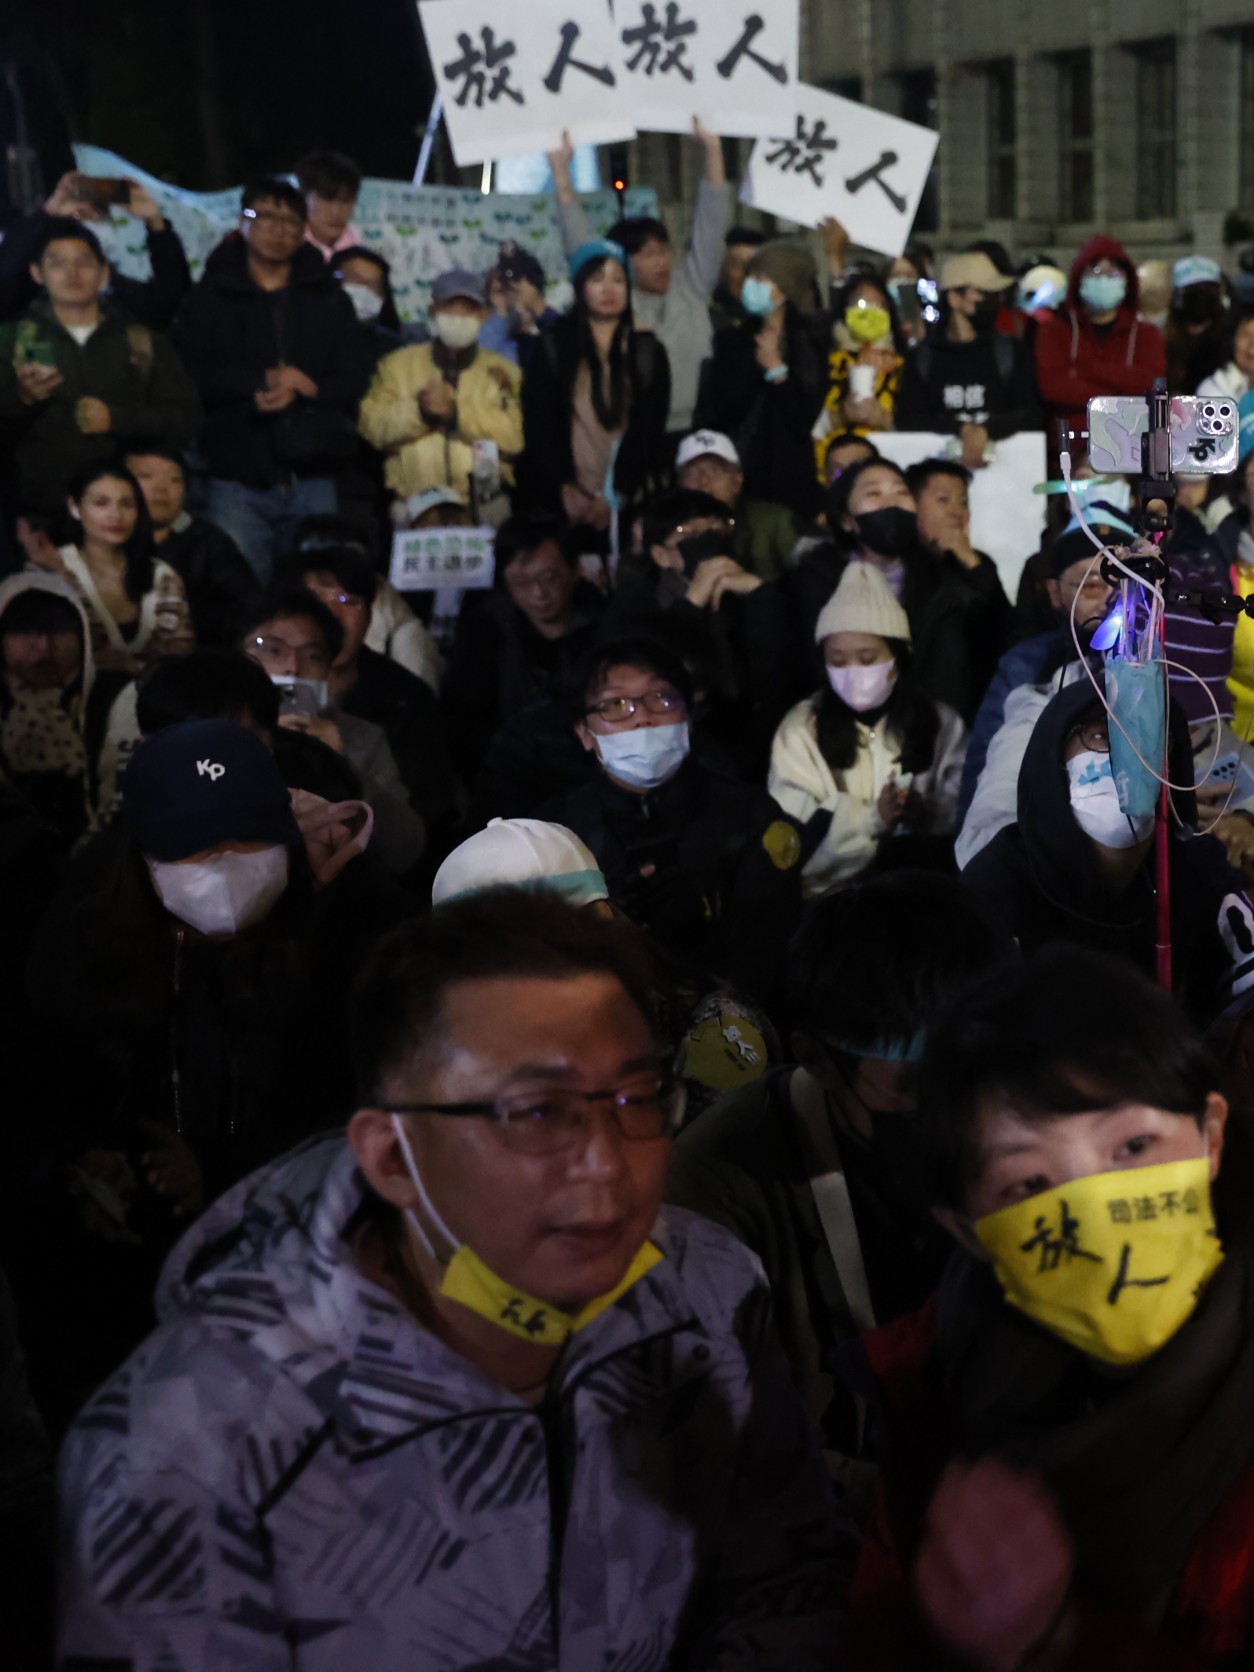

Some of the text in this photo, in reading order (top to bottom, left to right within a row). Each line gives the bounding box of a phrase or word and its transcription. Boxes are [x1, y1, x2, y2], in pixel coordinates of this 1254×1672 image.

[444, 20, 617, 108] 放人
[622, 1, 788, 84] 放人
[765, 114, 909, 214] 放人
[1020, 1198, 1171, 1306] 放人
